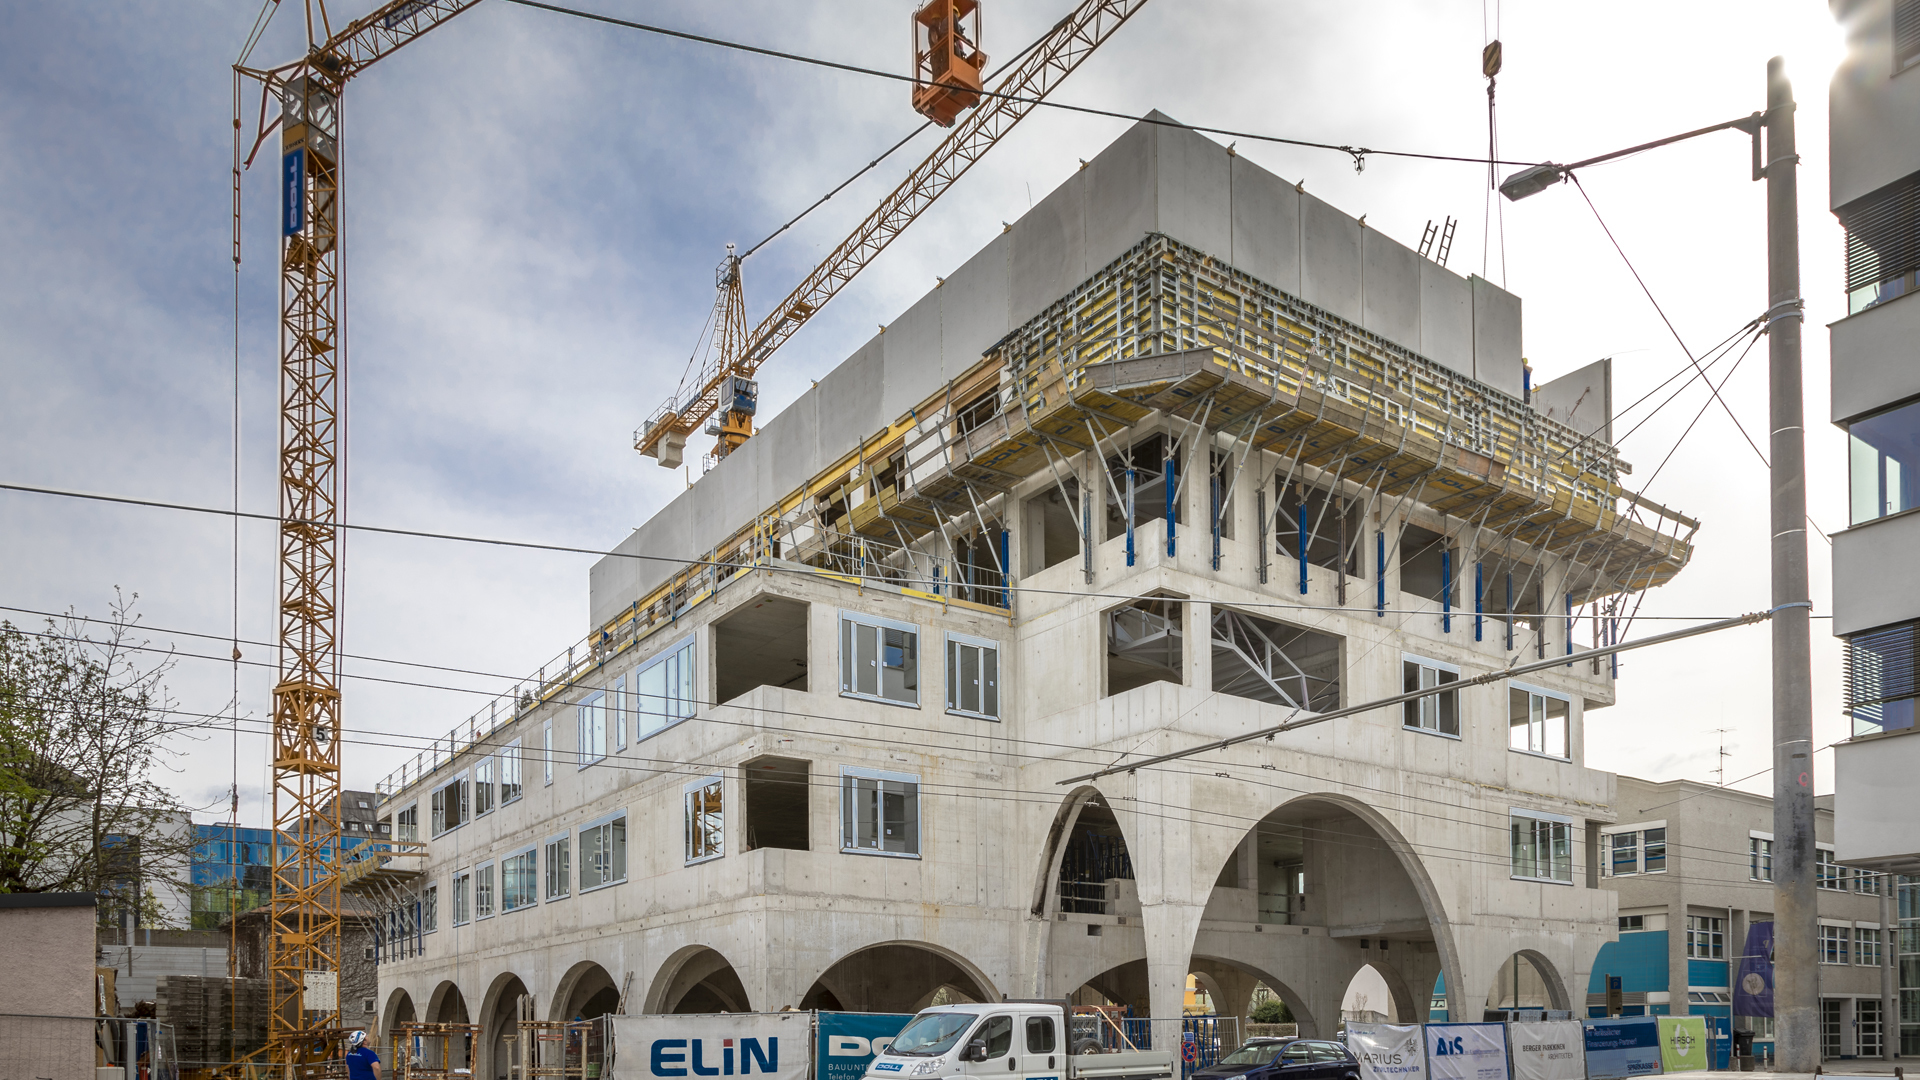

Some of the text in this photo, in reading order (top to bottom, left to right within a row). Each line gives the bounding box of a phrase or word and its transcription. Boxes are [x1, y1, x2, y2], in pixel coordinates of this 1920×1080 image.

[1670, 1036, 1695, 1044] HIRSCH
[1522, 1044, 1542, 1052] BERGER
[1354, 1051, 1402, 1065] MARIUS
[1627, 1063, 1653, 1071] SPARKASSE
